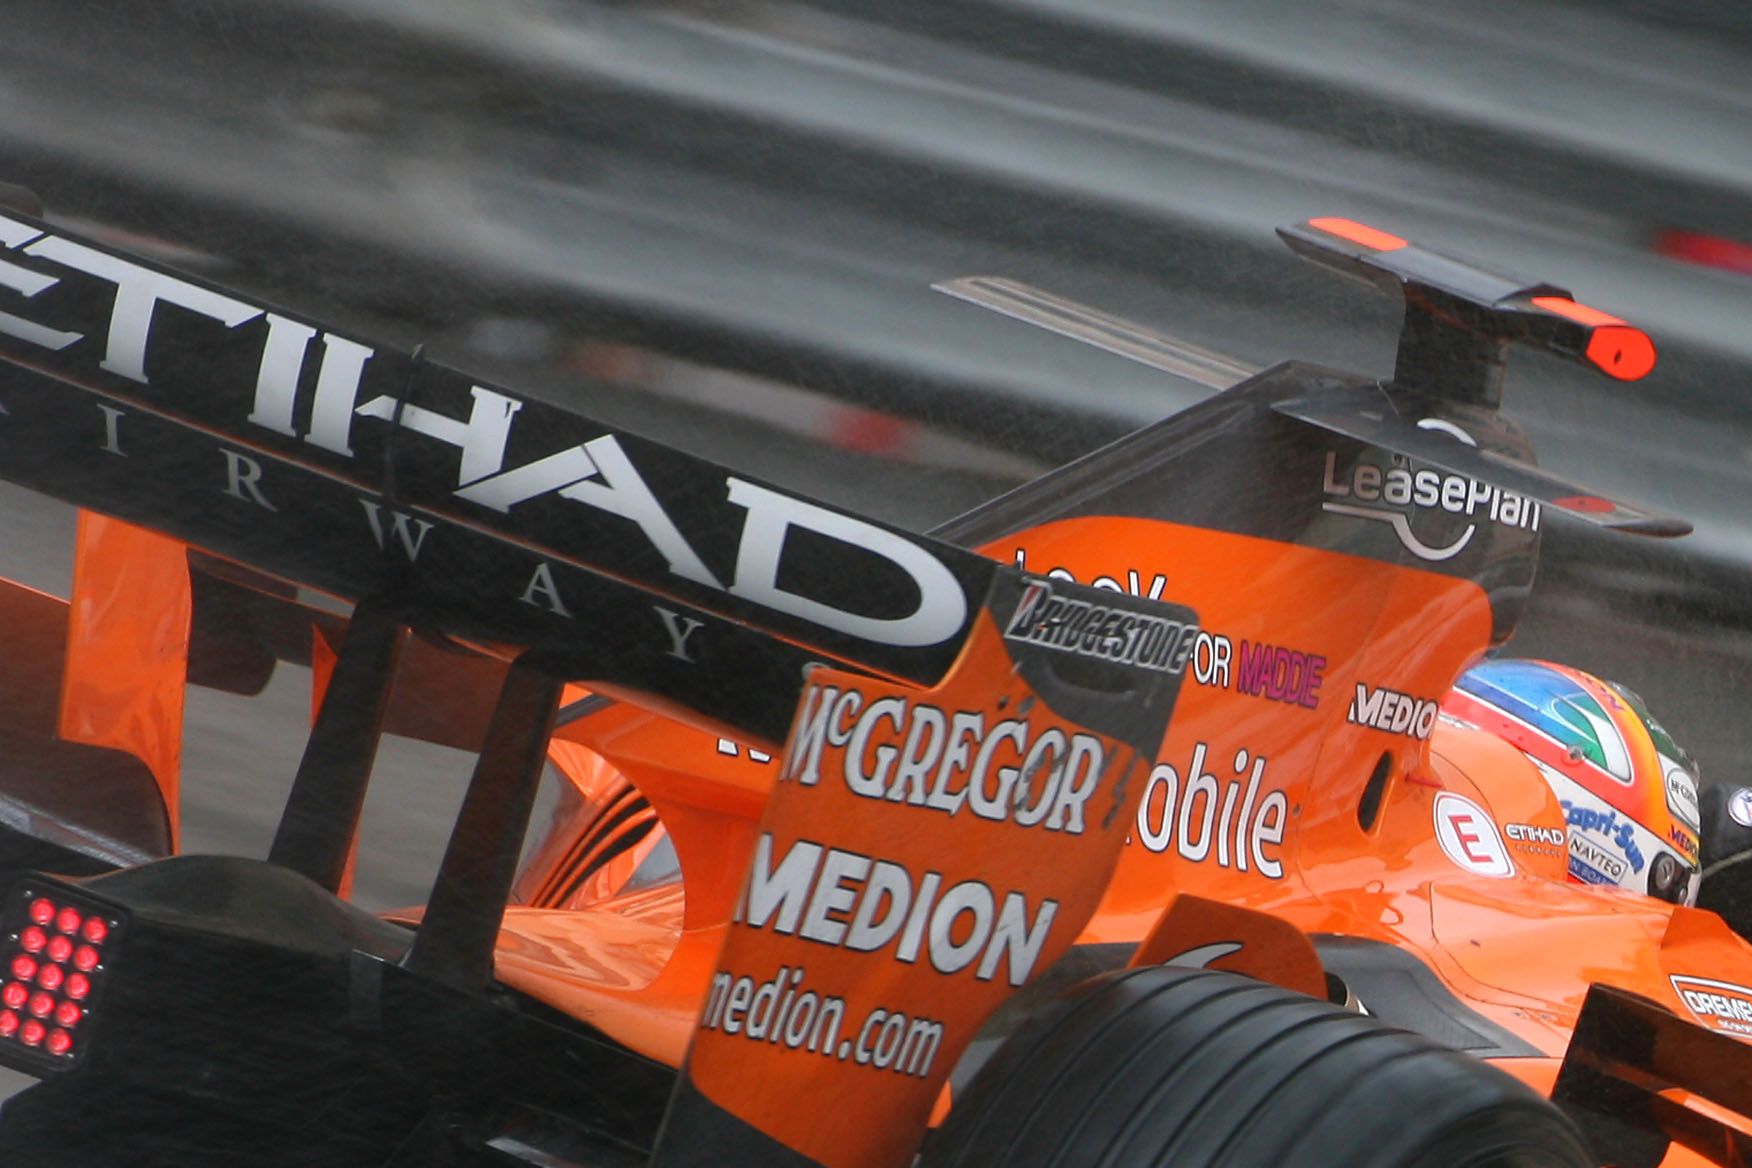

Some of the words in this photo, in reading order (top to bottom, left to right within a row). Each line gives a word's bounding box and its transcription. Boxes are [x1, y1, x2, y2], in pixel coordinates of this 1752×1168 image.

[1323, 449, 1541, 532] LeasePlan
[1004, 578, 1197, 675] BRIDGESTONE
[1191, 630, 1232, 687] OR
[1237, 640, 1327, 709] MADDIE
[1126, 741, 1289, 880] obile
[1504, 823, 1566, 846] ETIHAD
[732, 833, 1058, 986] MEDION
